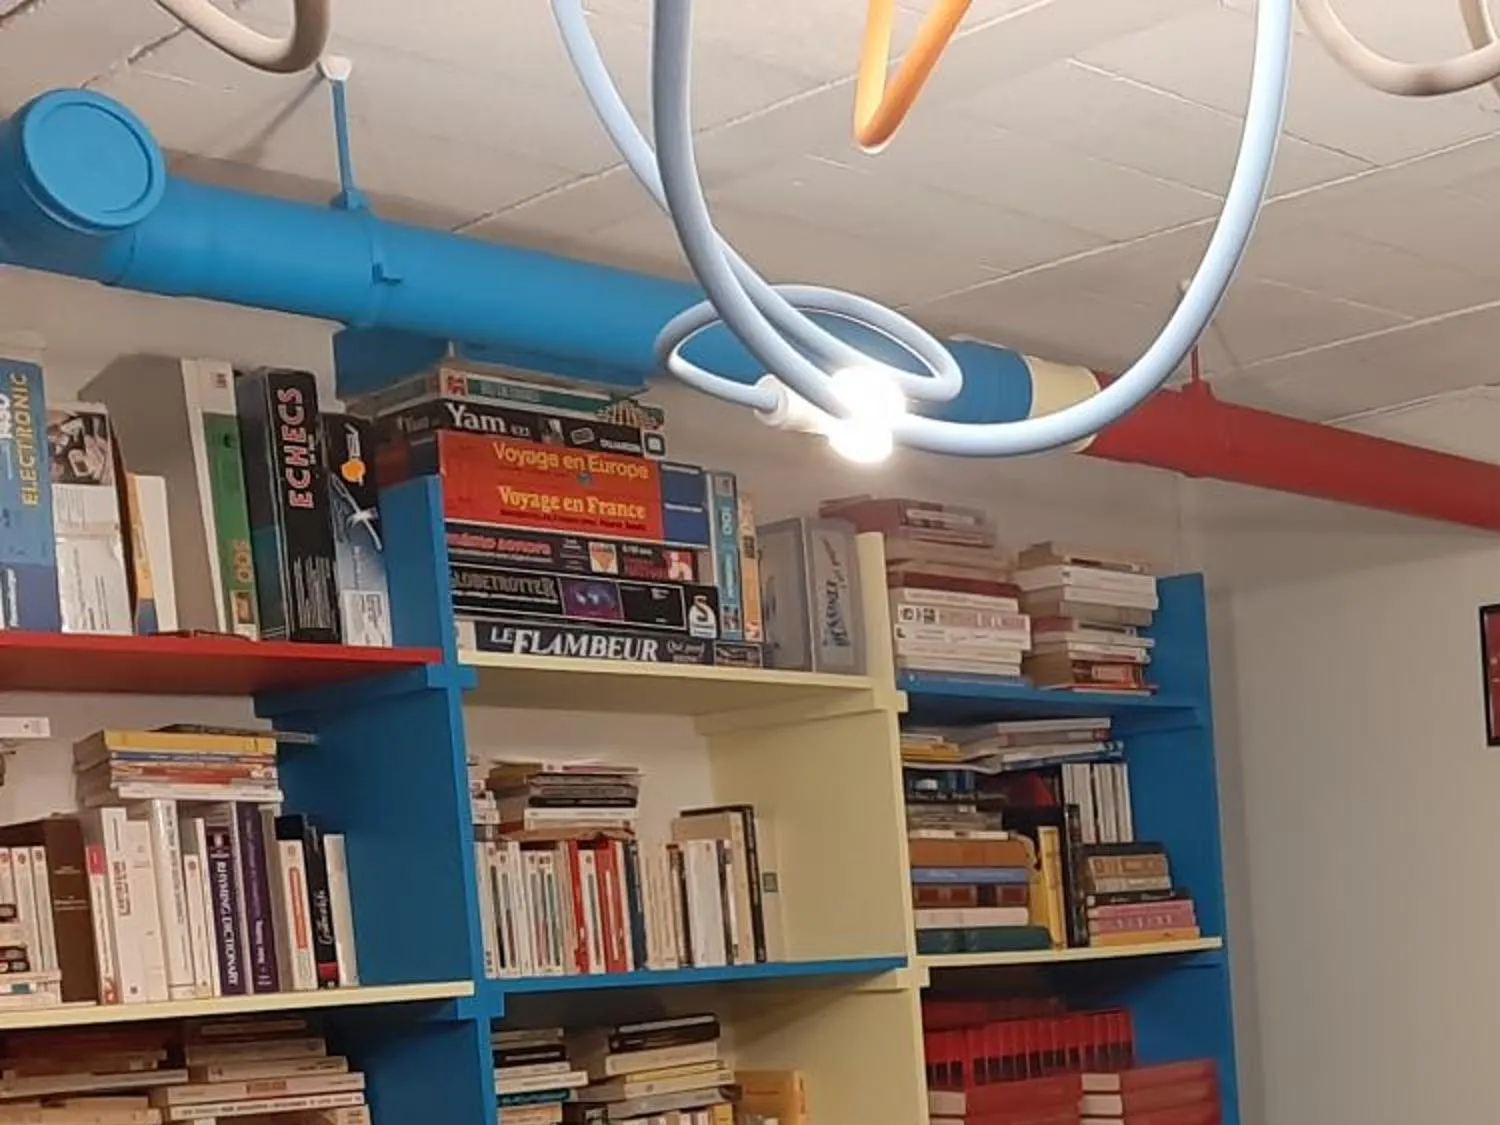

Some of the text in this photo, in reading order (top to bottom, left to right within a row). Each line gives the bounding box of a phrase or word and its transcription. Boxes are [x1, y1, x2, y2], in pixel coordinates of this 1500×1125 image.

[446, 402, 506, 434] Yam
[563, 453, 587, 472] en
[587, 454, 650, 480] Europe
[497, 486, 561, 514] Voyage
[563, 495, 584, 513] en
[586, 496, 647, 520] France
[490, 625, 513, 644] LE
[513, 627, 660, 662] FLAMBEUR
